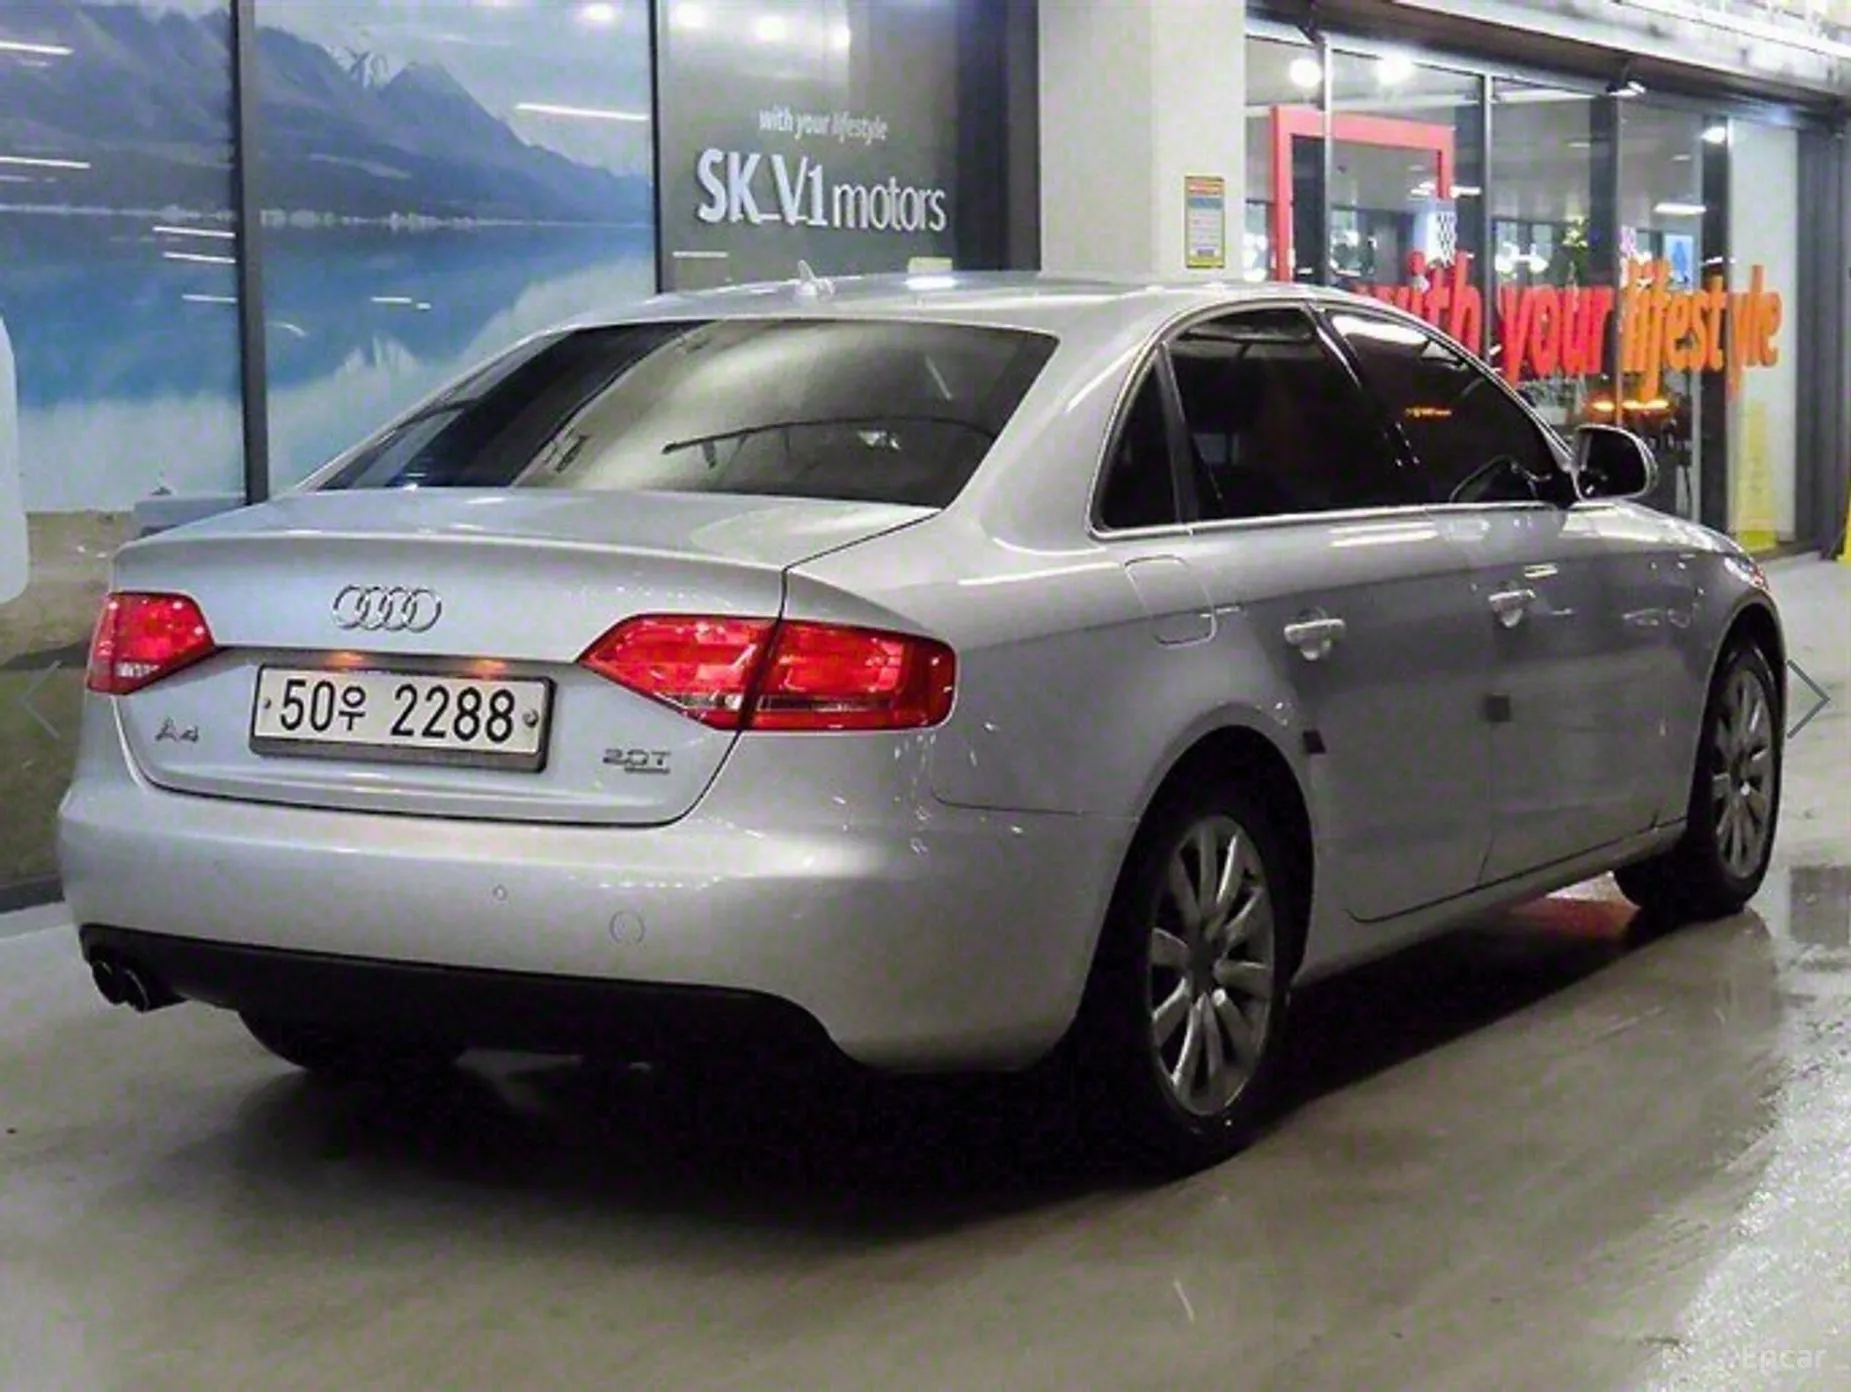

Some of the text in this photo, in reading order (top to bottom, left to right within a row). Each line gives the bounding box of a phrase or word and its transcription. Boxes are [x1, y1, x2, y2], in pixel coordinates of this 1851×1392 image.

[759, 105, 888, 145] with your lifestyle
[697, 147, 948, 232] SK V1 motors
[1353, 250, 1783, 403] ith your lifestyle
[155, 716, 199, 743] A4
[279, 678, 516, 743] 50우 2288
